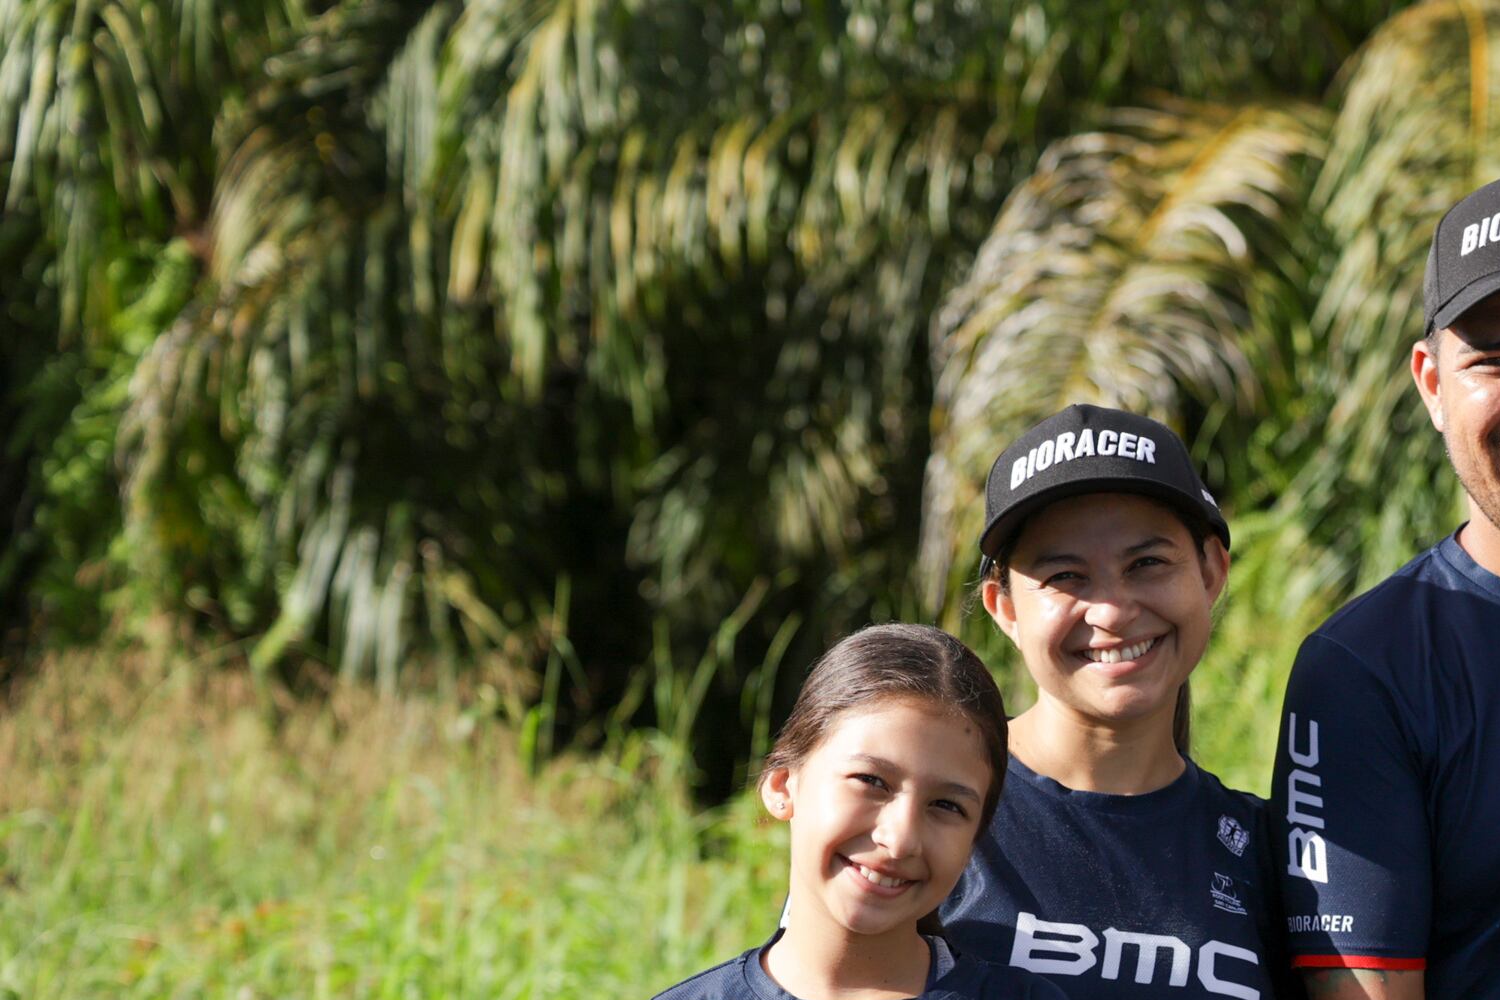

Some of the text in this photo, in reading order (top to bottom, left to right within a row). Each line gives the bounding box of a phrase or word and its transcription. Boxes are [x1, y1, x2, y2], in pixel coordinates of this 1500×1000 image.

[1010, 428, 1156, 491] BIORACER
[1286, 712, 1328, 884] BMC
[1288, 914, 1354, 934] BIORACER
